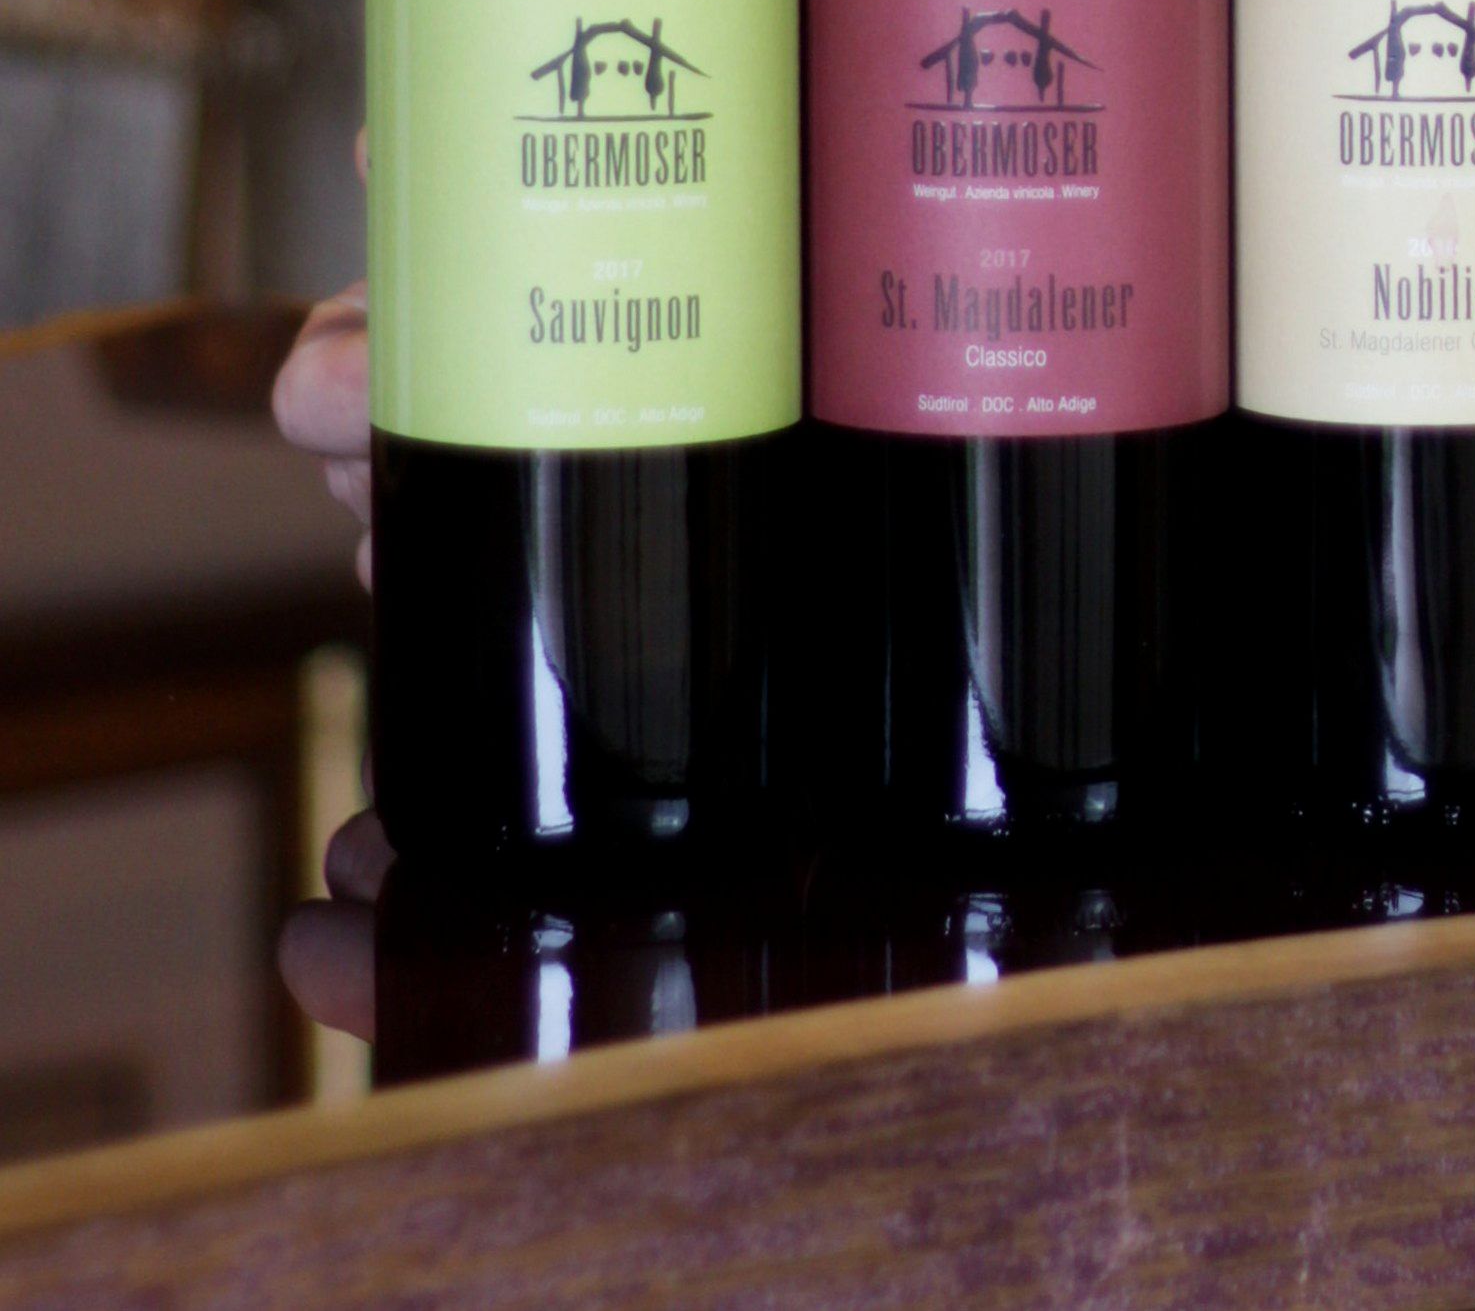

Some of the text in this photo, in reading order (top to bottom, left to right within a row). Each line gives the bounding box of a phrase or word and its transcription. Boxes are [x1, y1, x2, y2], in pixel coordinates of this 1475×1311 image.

[521, 129, 706, 187] OBERMOSER
[912, 119, 1098, 177] OBERMOSER
[913, 183, 1100, 202] Weingut Azienda vinicola Winery
[593, 260, 643, 280] 2017
[979, 249, 1031, 268] 2017
[881, 268, 1134, 341] St. Magdalener
[529, 285, 701, 353] Sauvignon
[1319, 328, 1343, 350] St.
[1350, 330, 1462, 356] Magdalener
[965, 344, 1047, 368] Classico
[917, 394, 1096, 414] Südtirol DOC Alto Adige
